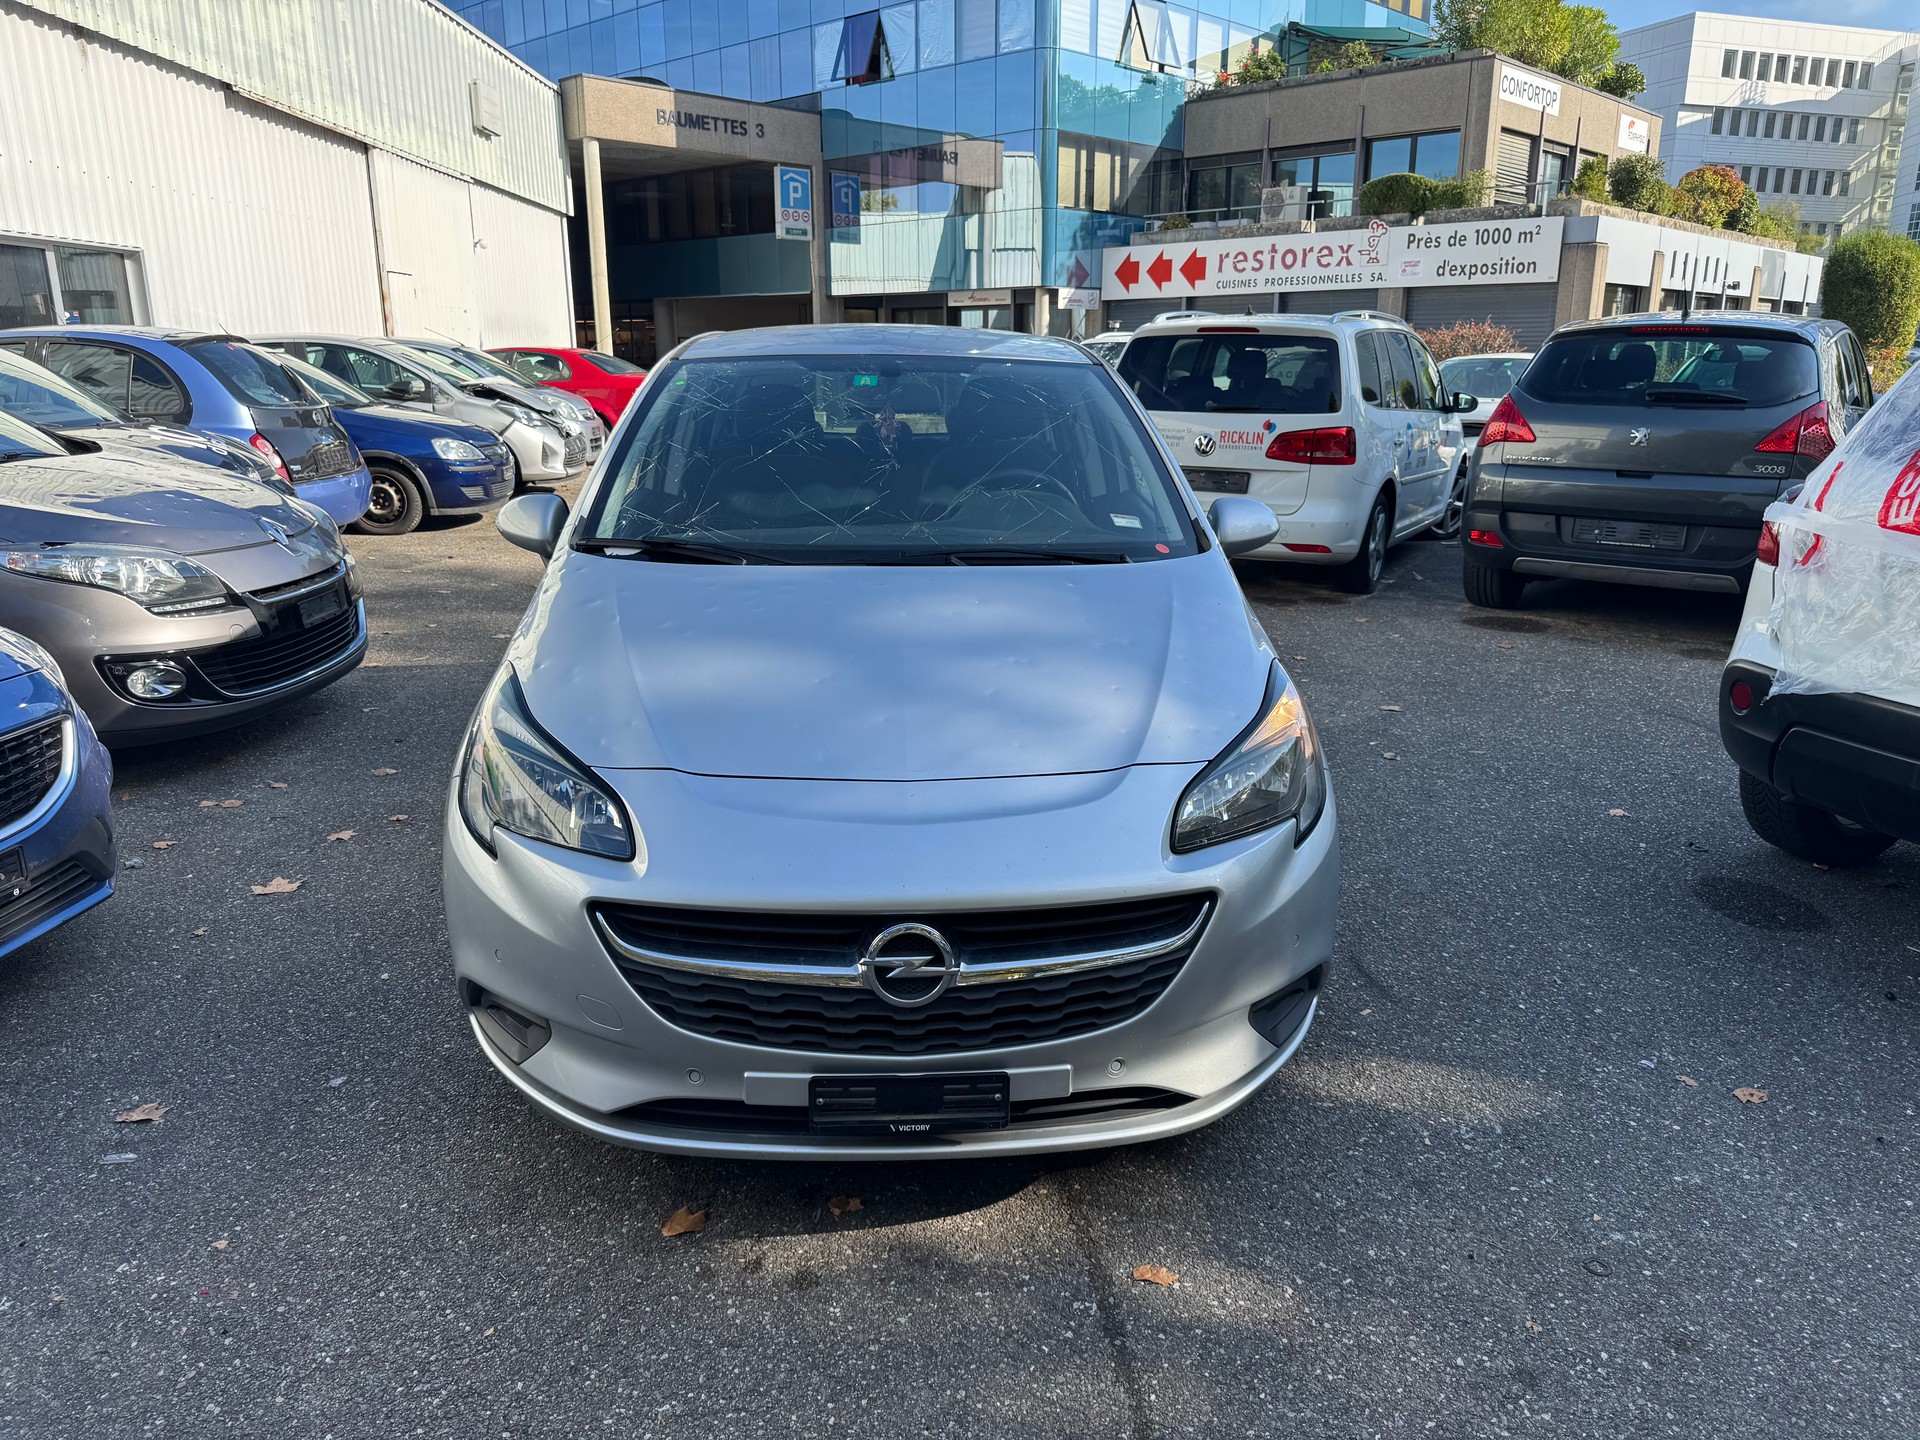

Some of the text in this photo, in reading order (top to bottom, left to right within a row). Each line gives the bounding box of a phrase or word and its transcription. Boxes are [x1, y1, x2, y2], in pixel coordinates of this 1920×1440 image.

[1501, 74, 1558, 108] CONFORTOP
[656, 108, 765, 138] BAUMETTES 3
[789, 181, 802, 207] P
[1406, 232, 1441, 250] Près
[1447, 230, 1467, 247] de
[1474, 227, 1512, 246] 1000
[1217, 243, 1354, 273] restorex
[1436, 257, 1537, 280] d'exposition
[1216, 271, 1387, 289] CUISINES PROFESSIONNELLES SA.
[1219, 430, 1265, 445] RICKLIN
[1506, 454, 1551, 462] PEUGEOT
[1753, 464, 1786, 474] 3008
